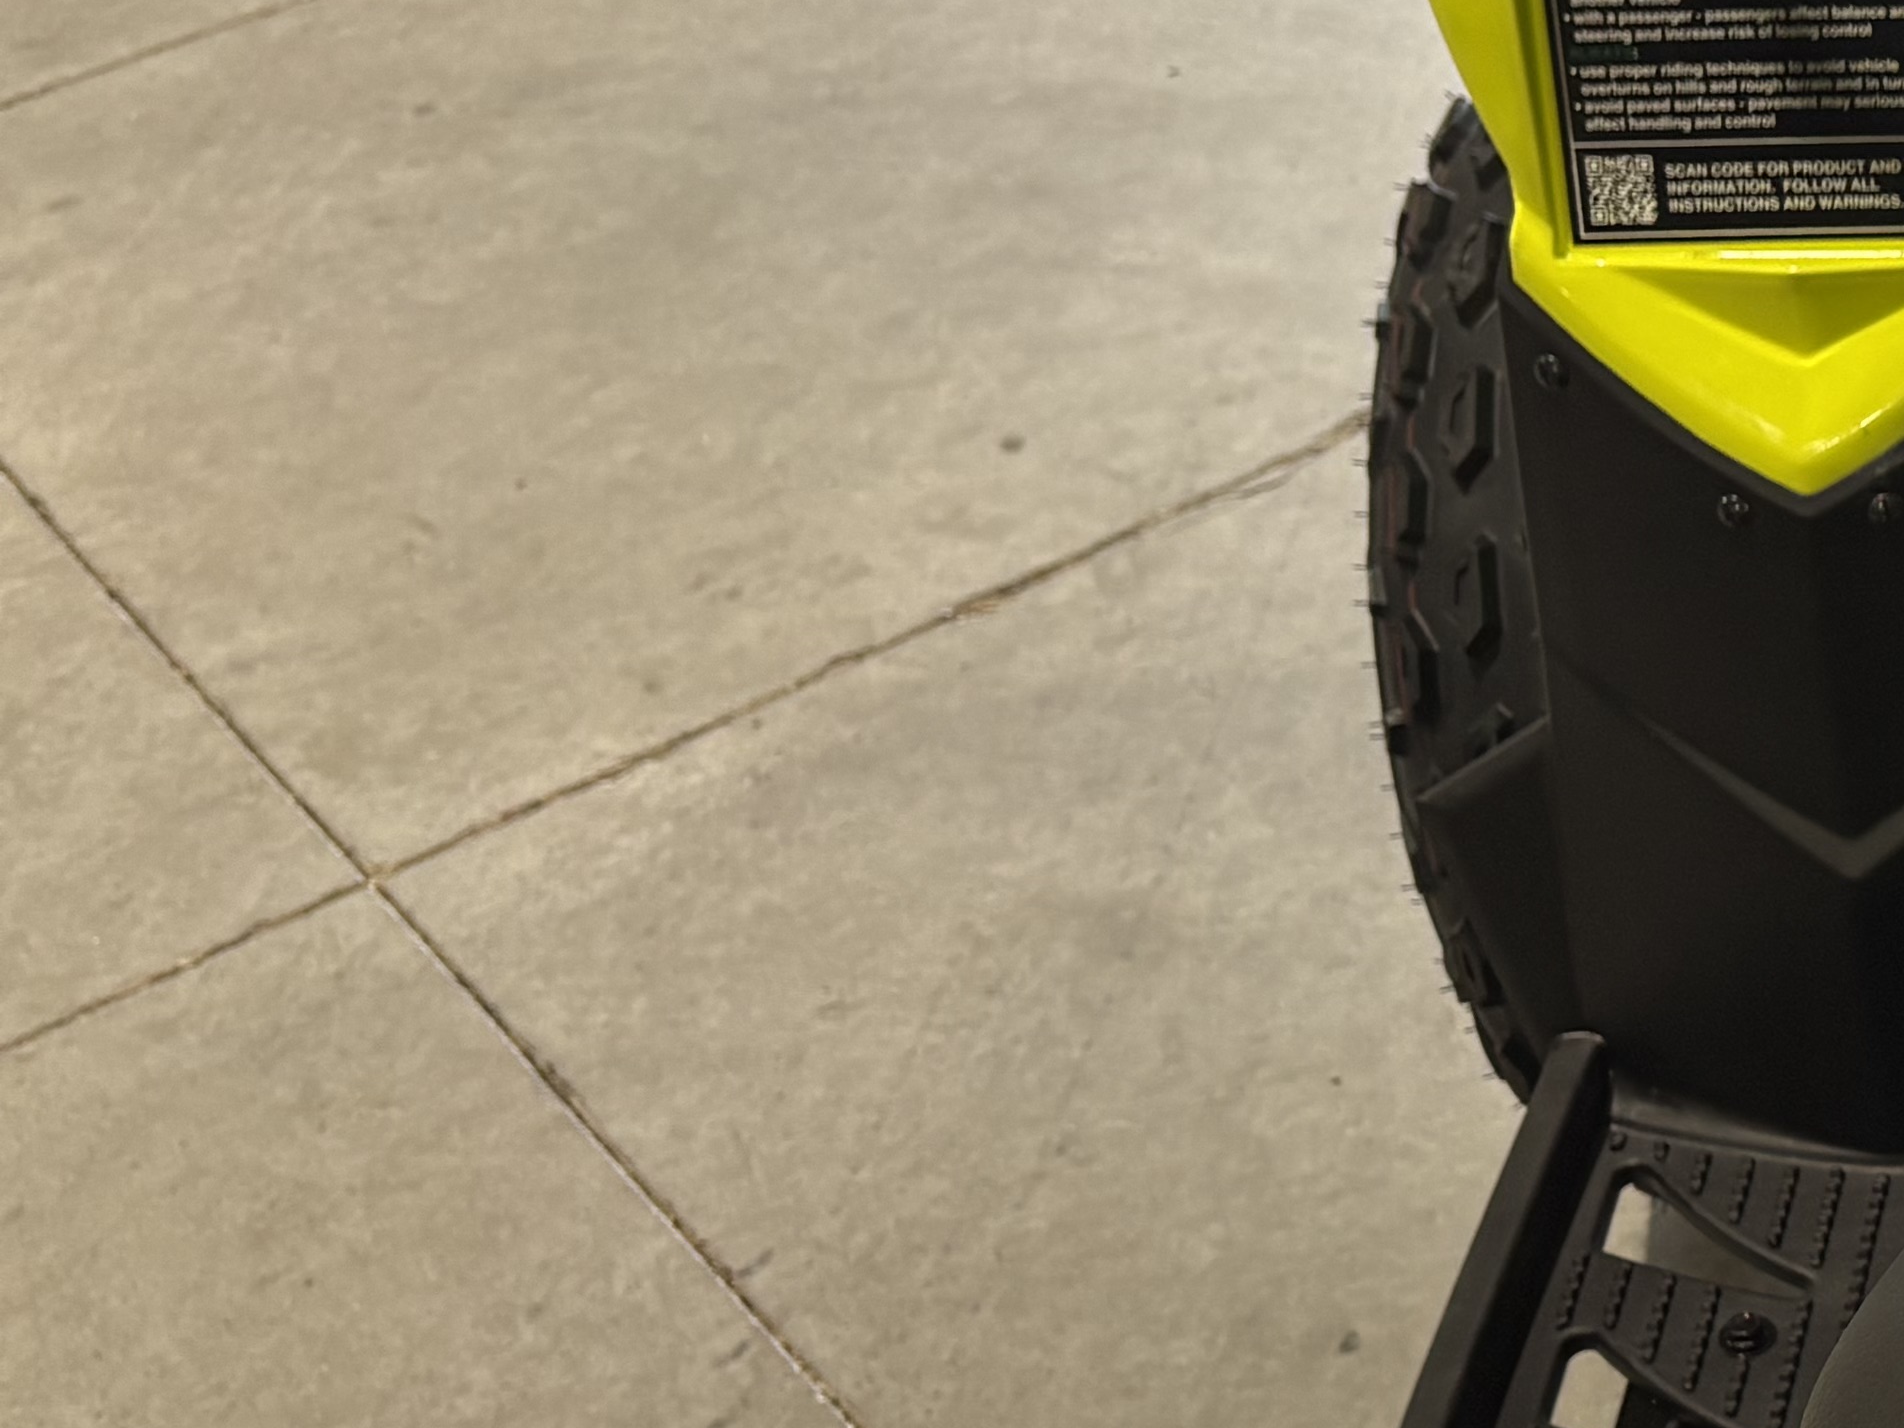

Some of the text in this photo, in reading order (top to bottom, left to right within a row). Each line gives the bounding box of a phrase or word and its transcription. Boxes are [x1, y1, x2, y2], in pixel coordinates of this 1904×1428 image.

[1666, 163, 1707, 178] SCAN
[1710, 163, 1753, 177] CODE
[1756, 162, 1788, 177] FOR
[1792, 161, 1864, 176] PRODUCT
[1868, 160, 1900, 175] AND
[1668, 178, 1879, 196] INFORMATION. FOLLOW ALL
[1670, 194, 1904, 213] INSTRUCTIONS AND WARNINGS.
